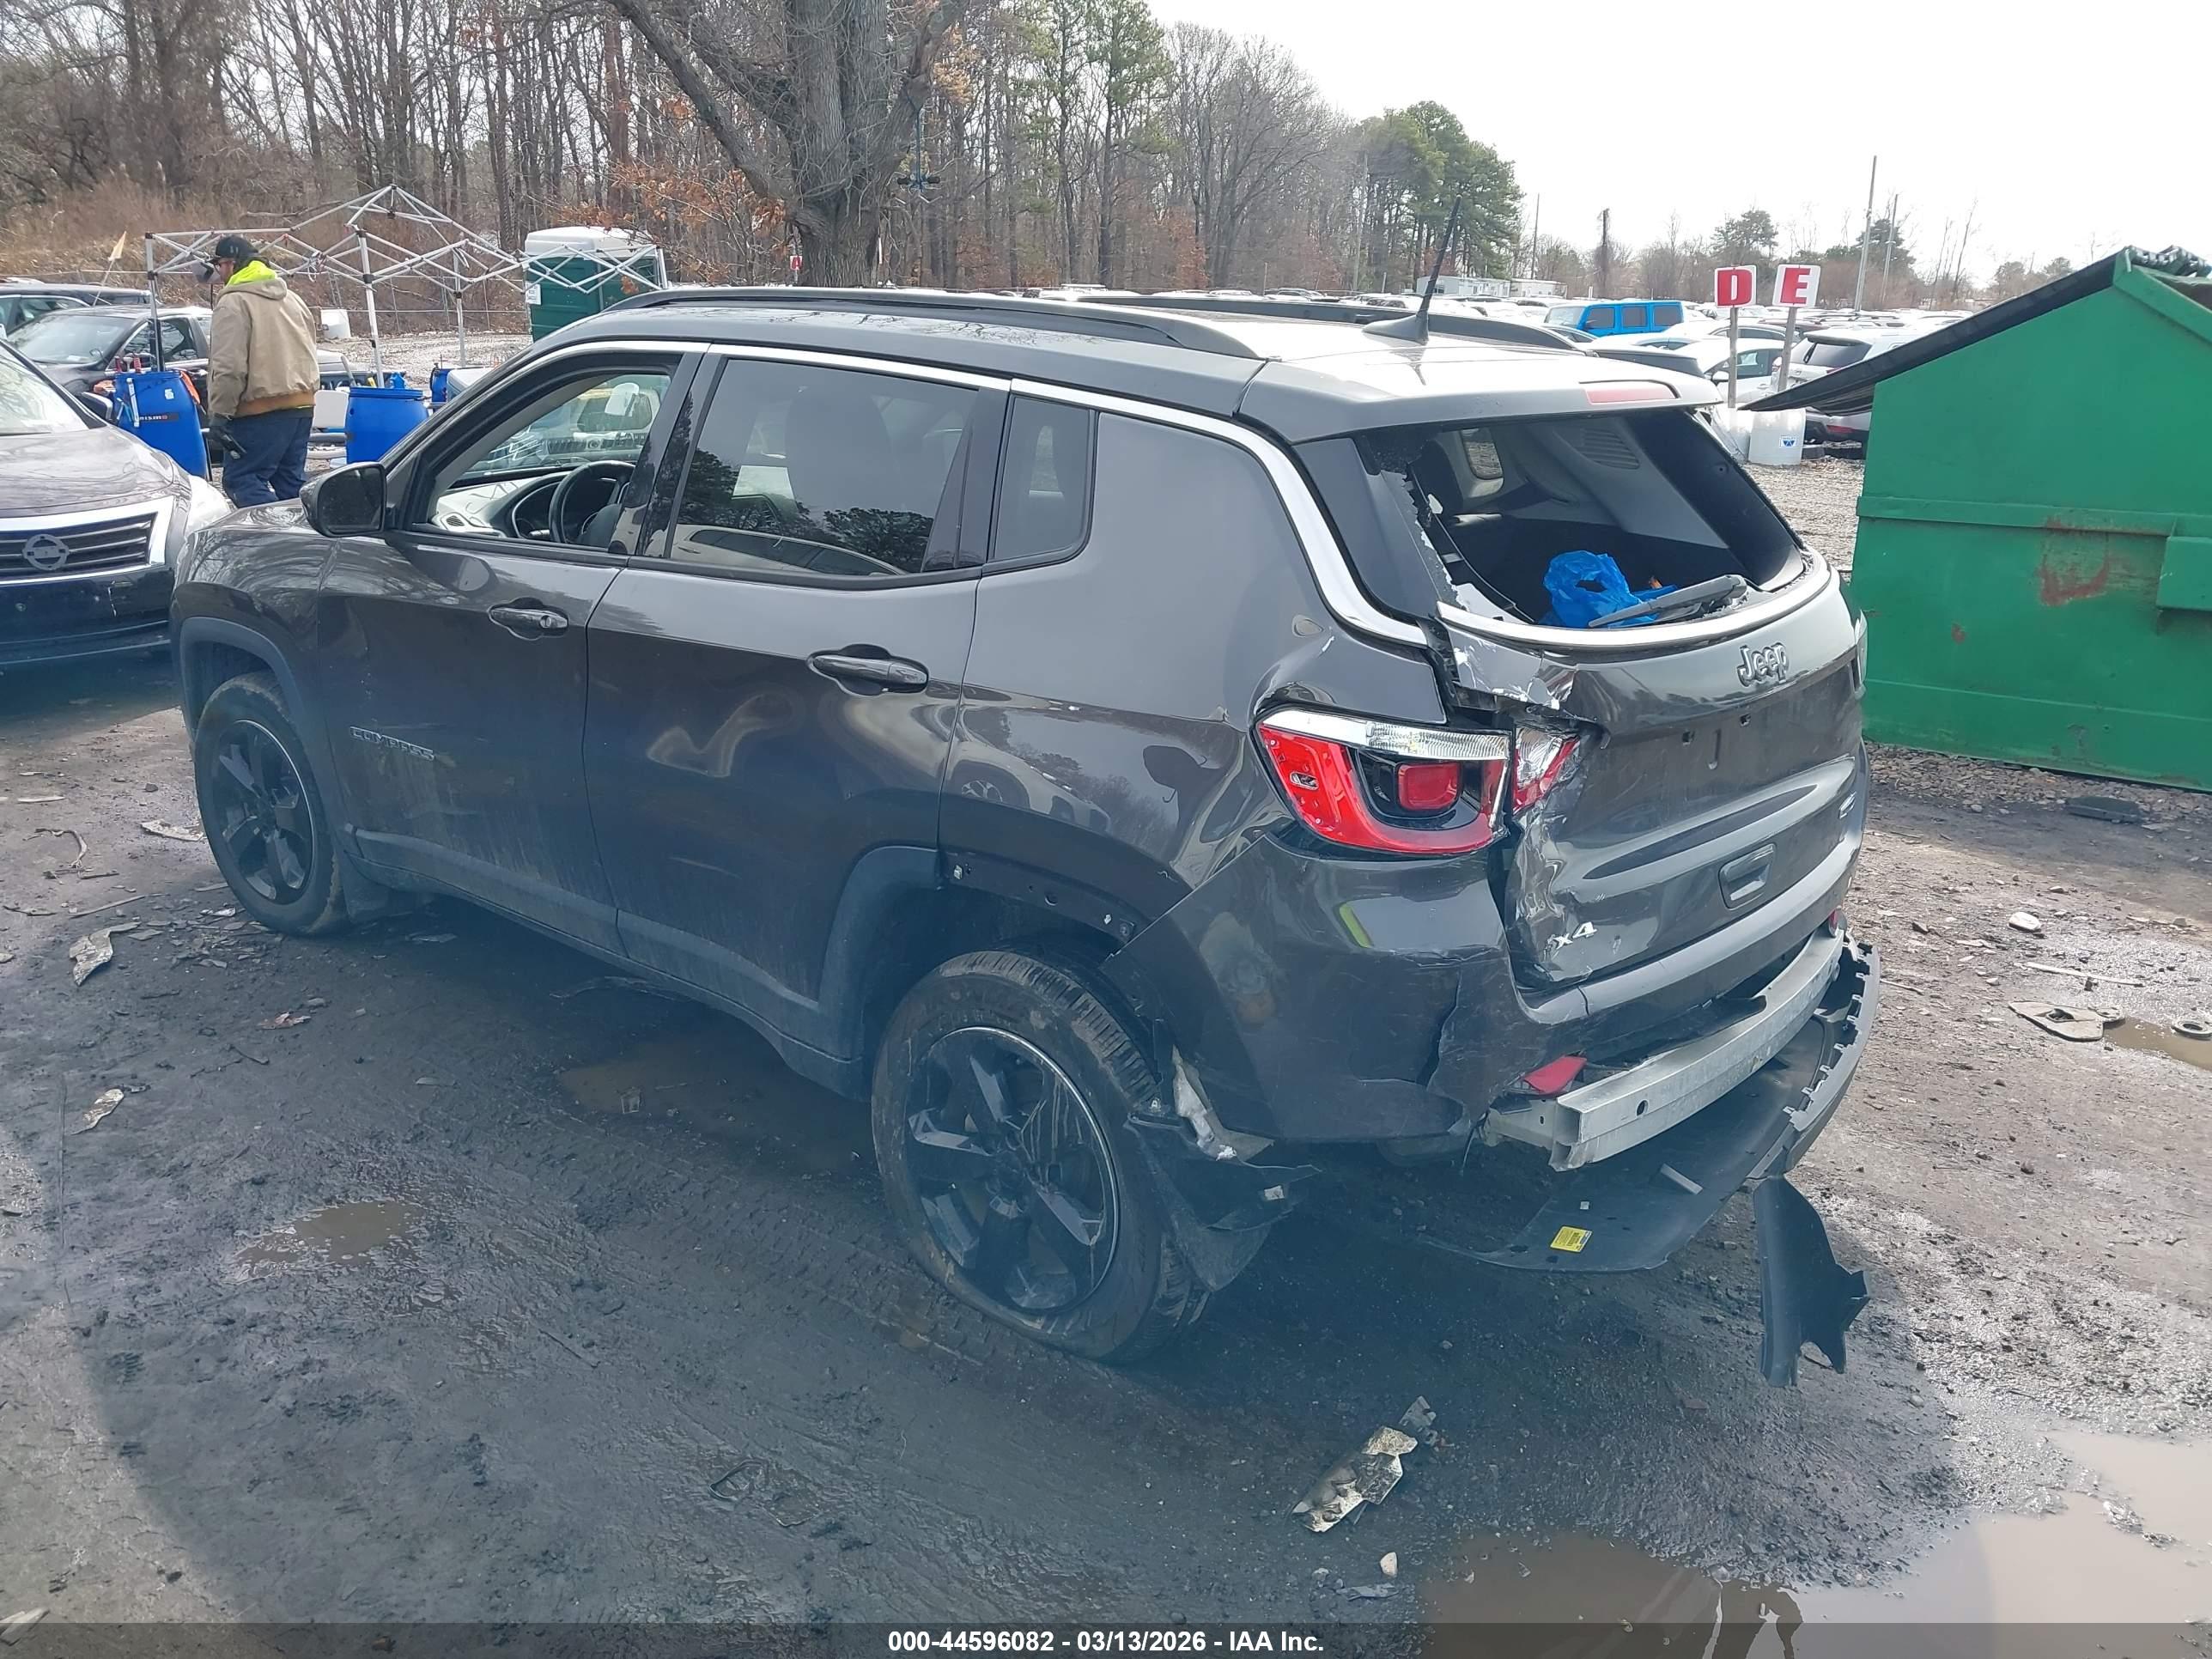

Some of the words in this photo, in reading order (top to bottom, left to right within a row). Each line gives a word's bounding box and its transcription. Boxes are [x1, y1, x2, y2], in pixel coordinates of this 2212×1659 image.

[1717, 269, 1752, 306] D
[1780, 268, 1811, 304] E
[1736, 642, 1789, 687] Jeep
[349, 726, 434, 761] COMPASS
